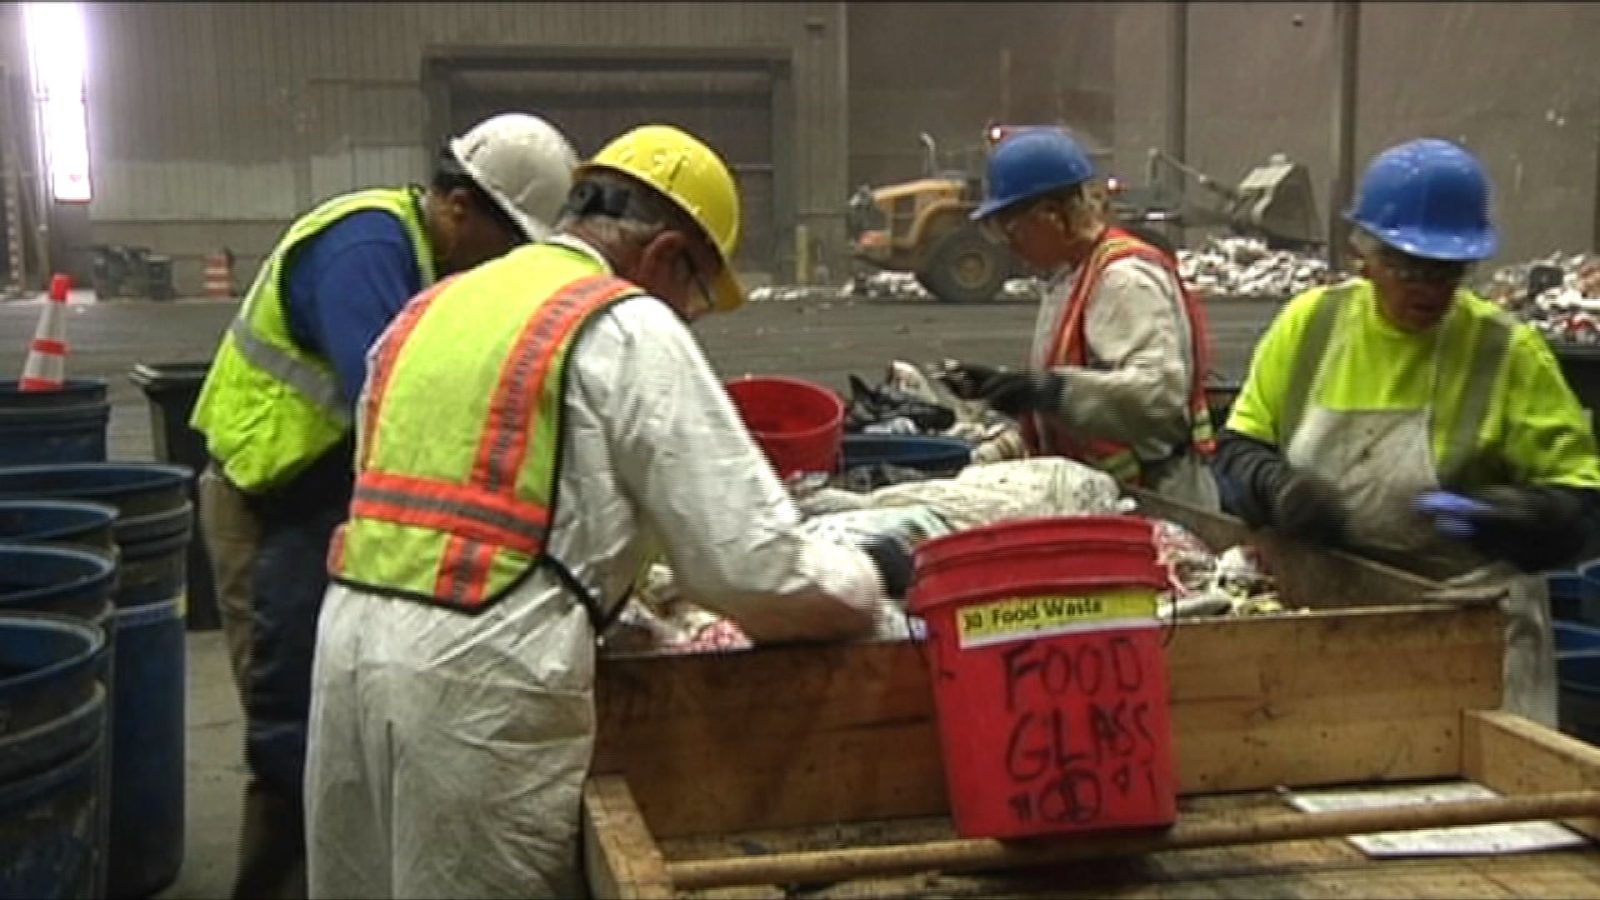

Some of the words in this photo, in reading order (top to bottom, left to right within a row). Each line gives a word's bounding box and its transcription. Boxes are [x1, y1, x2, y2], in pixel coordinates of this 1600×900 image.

[992, 602, 1038, 625] Food
[1042, 597, 1102, 617] Waste
[1003, 637, 1143, 712] FOOD
[1005, 700, 1156, 783] GLASS
